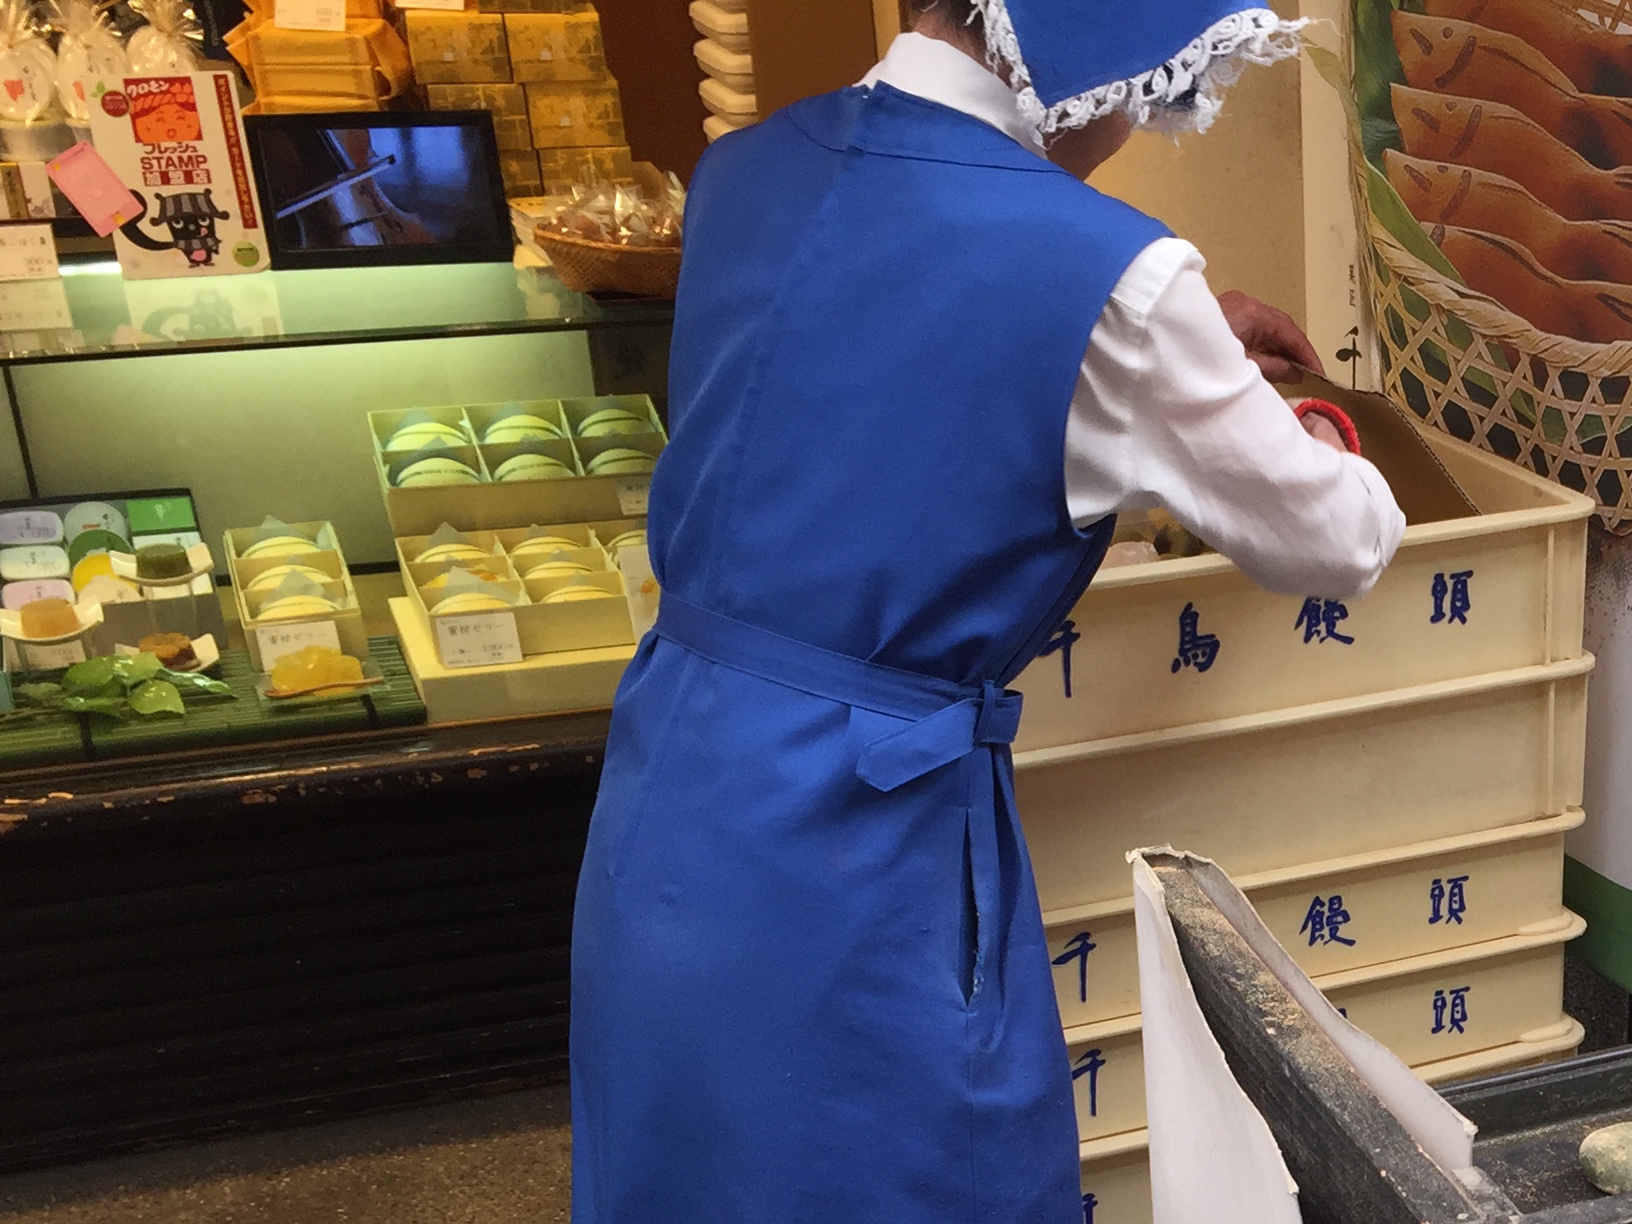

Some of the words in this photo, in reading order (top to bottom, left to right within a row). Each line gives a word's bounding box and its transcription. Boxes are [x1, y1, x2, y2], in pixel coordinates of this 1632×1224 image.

[144, 142, 198, 155] フレッシュ
[140, 154, 209, 171] STAMP
[145, 169, 211, 186] 加盟店
